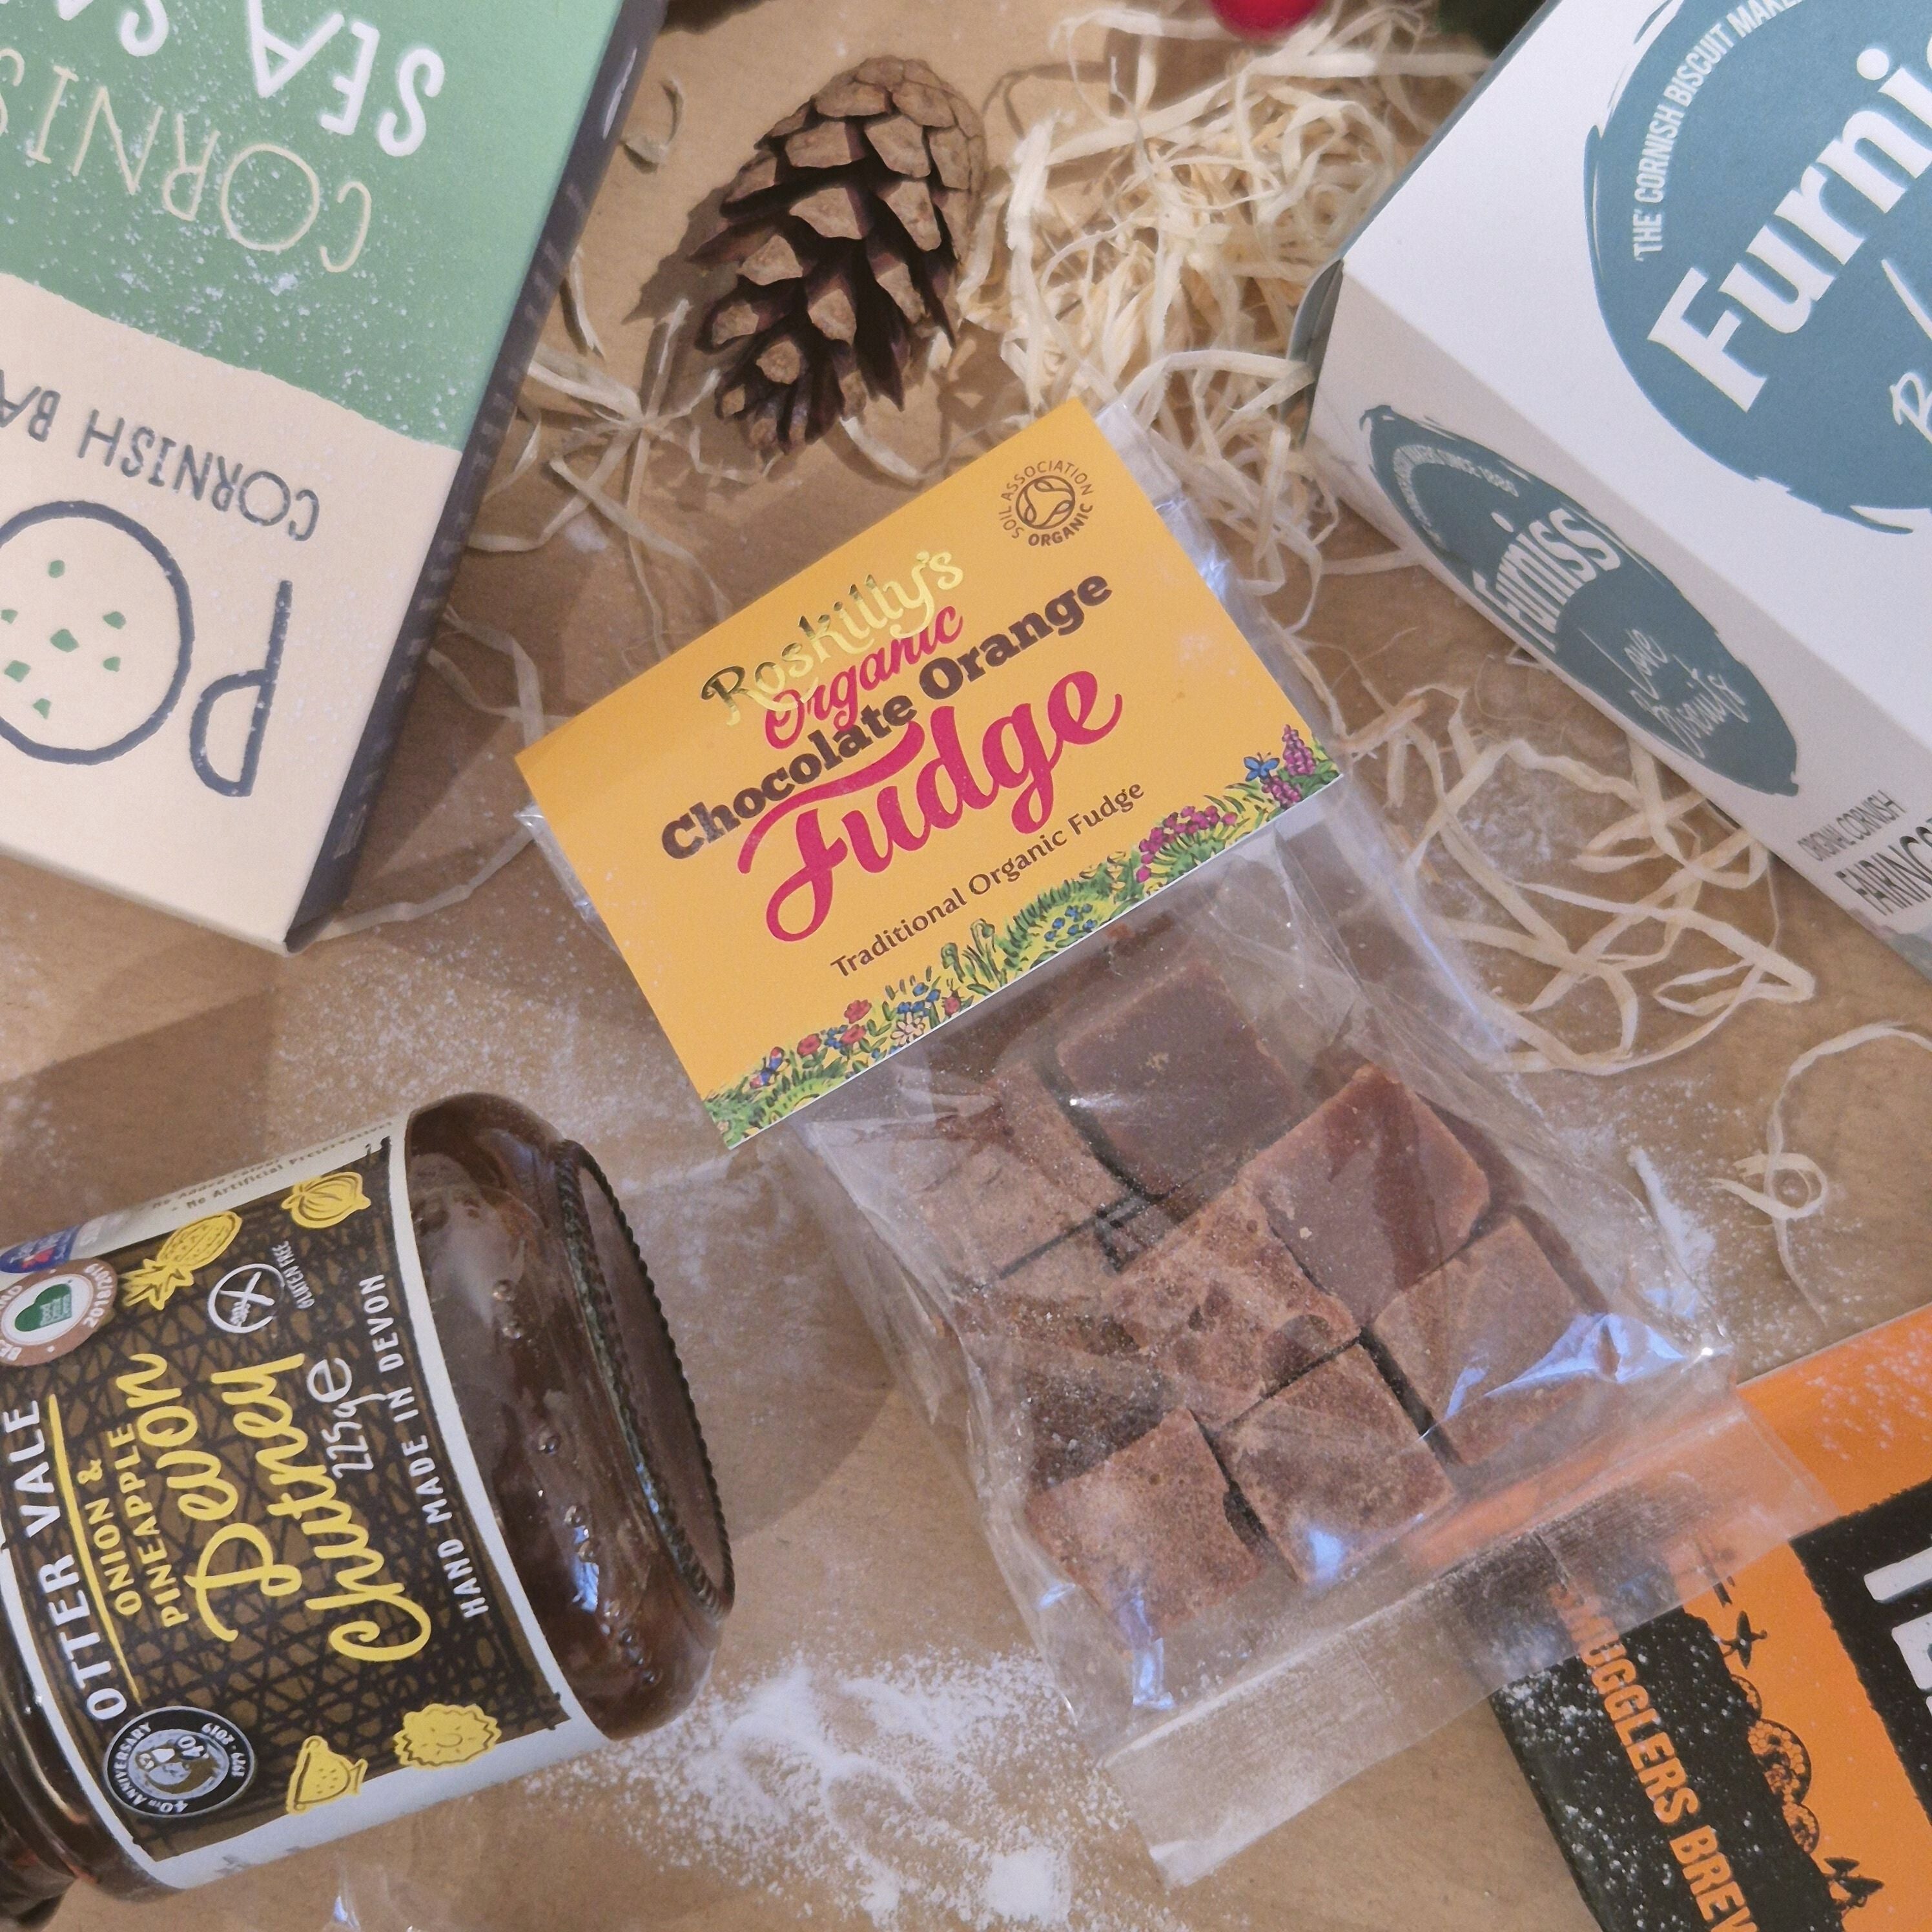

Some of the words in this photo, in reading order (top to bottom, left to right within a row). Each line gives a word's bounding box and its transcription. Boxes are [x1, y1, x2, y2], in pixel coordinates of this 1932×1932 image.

[248, 0, 445, 157] SEA
[1634, 103, 1685, 203] CORNISH
[1663, 22, 1735, 108] BISCUIT
[1647, 35, 1932, 412] Furni
[77, 409, 320, 541] CORNISH
[999, 506, 1025, 539] SOIL
[1001, 460, 1094, 501] ASSOCIATION
[1028, 503, 1093, 547] ORGANIC
[700, 550, 964, 727] Roskilly's
[1473, 508, 1621, 653] Furniss
[661, 694, 918, 861] Chocolate
[918, 574, 1112, 701] Orange
[765, 606, 964, 750] Organic
[736, 670, 1124, 943] Fudge
[1836, 790, 1906, 840] CORNISH
[830, 887, 968, 978] Traditional
[968, 829, 1068, 896] Organic
[1067, 783, 1145, 836] Fudge
[272, 1240, 296, 1268] FREE
[283, 1266, 315, 1309] GLUTEN
[359, 1274, 406, 1373] DEVON
[2, 1401, 61, 1537] VALE
[77, 1458, 103, 1484] &
[389, 1386, 419, 1423] IN
[107, 1423, 189, 1628] PINEAPPLE
[116, 1353, 302, 1641] Devon
[211, 1353, 431, 1662] Chutney
[402, 1435, 452, 1524] MADE
[84, 1497, 143, 1616] ONION
[437, 1539, 489, 1618] HAND
[38, 1554, 127, 1720] OTTER
[114, 1721, 152, 1807] ANNIVERSARY
